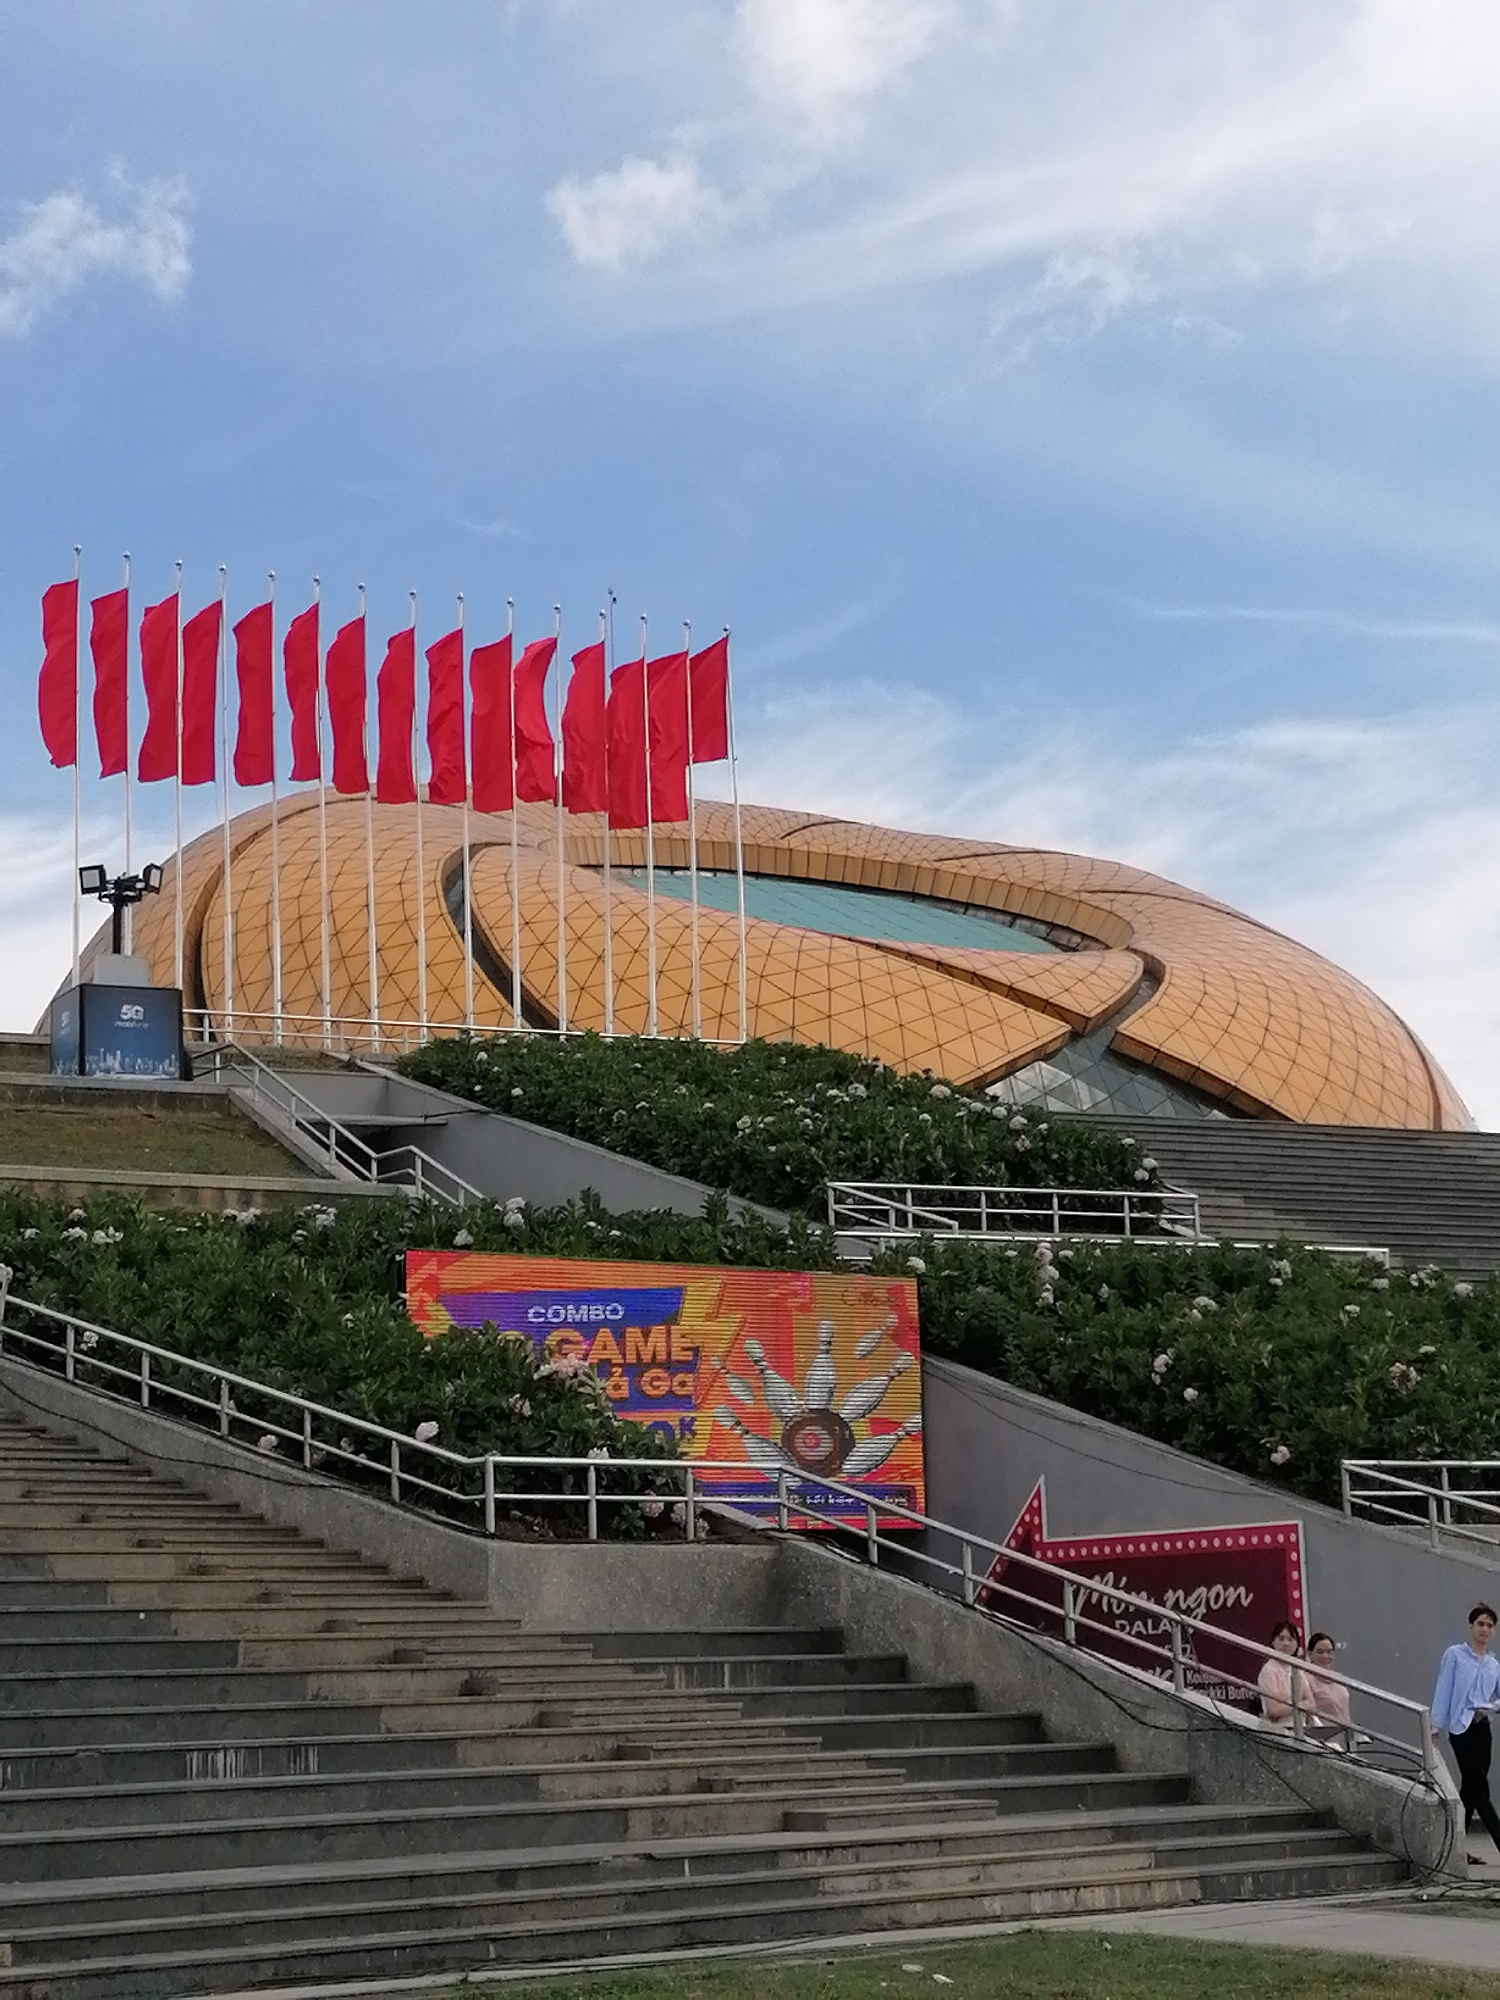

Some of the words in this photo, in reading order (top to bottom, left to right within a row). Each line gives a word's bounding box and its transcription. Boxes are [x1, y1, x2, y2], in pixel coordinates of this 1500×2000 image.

[120, 1004, 144, 1020] 5G
[527, 1302, 625, 1323] COMBO
[543, 1326, 699, 1365] GAME
[1163, 1583, 1254, 1633] ngon
[1115, 1617, 1178, 1636] DALA
